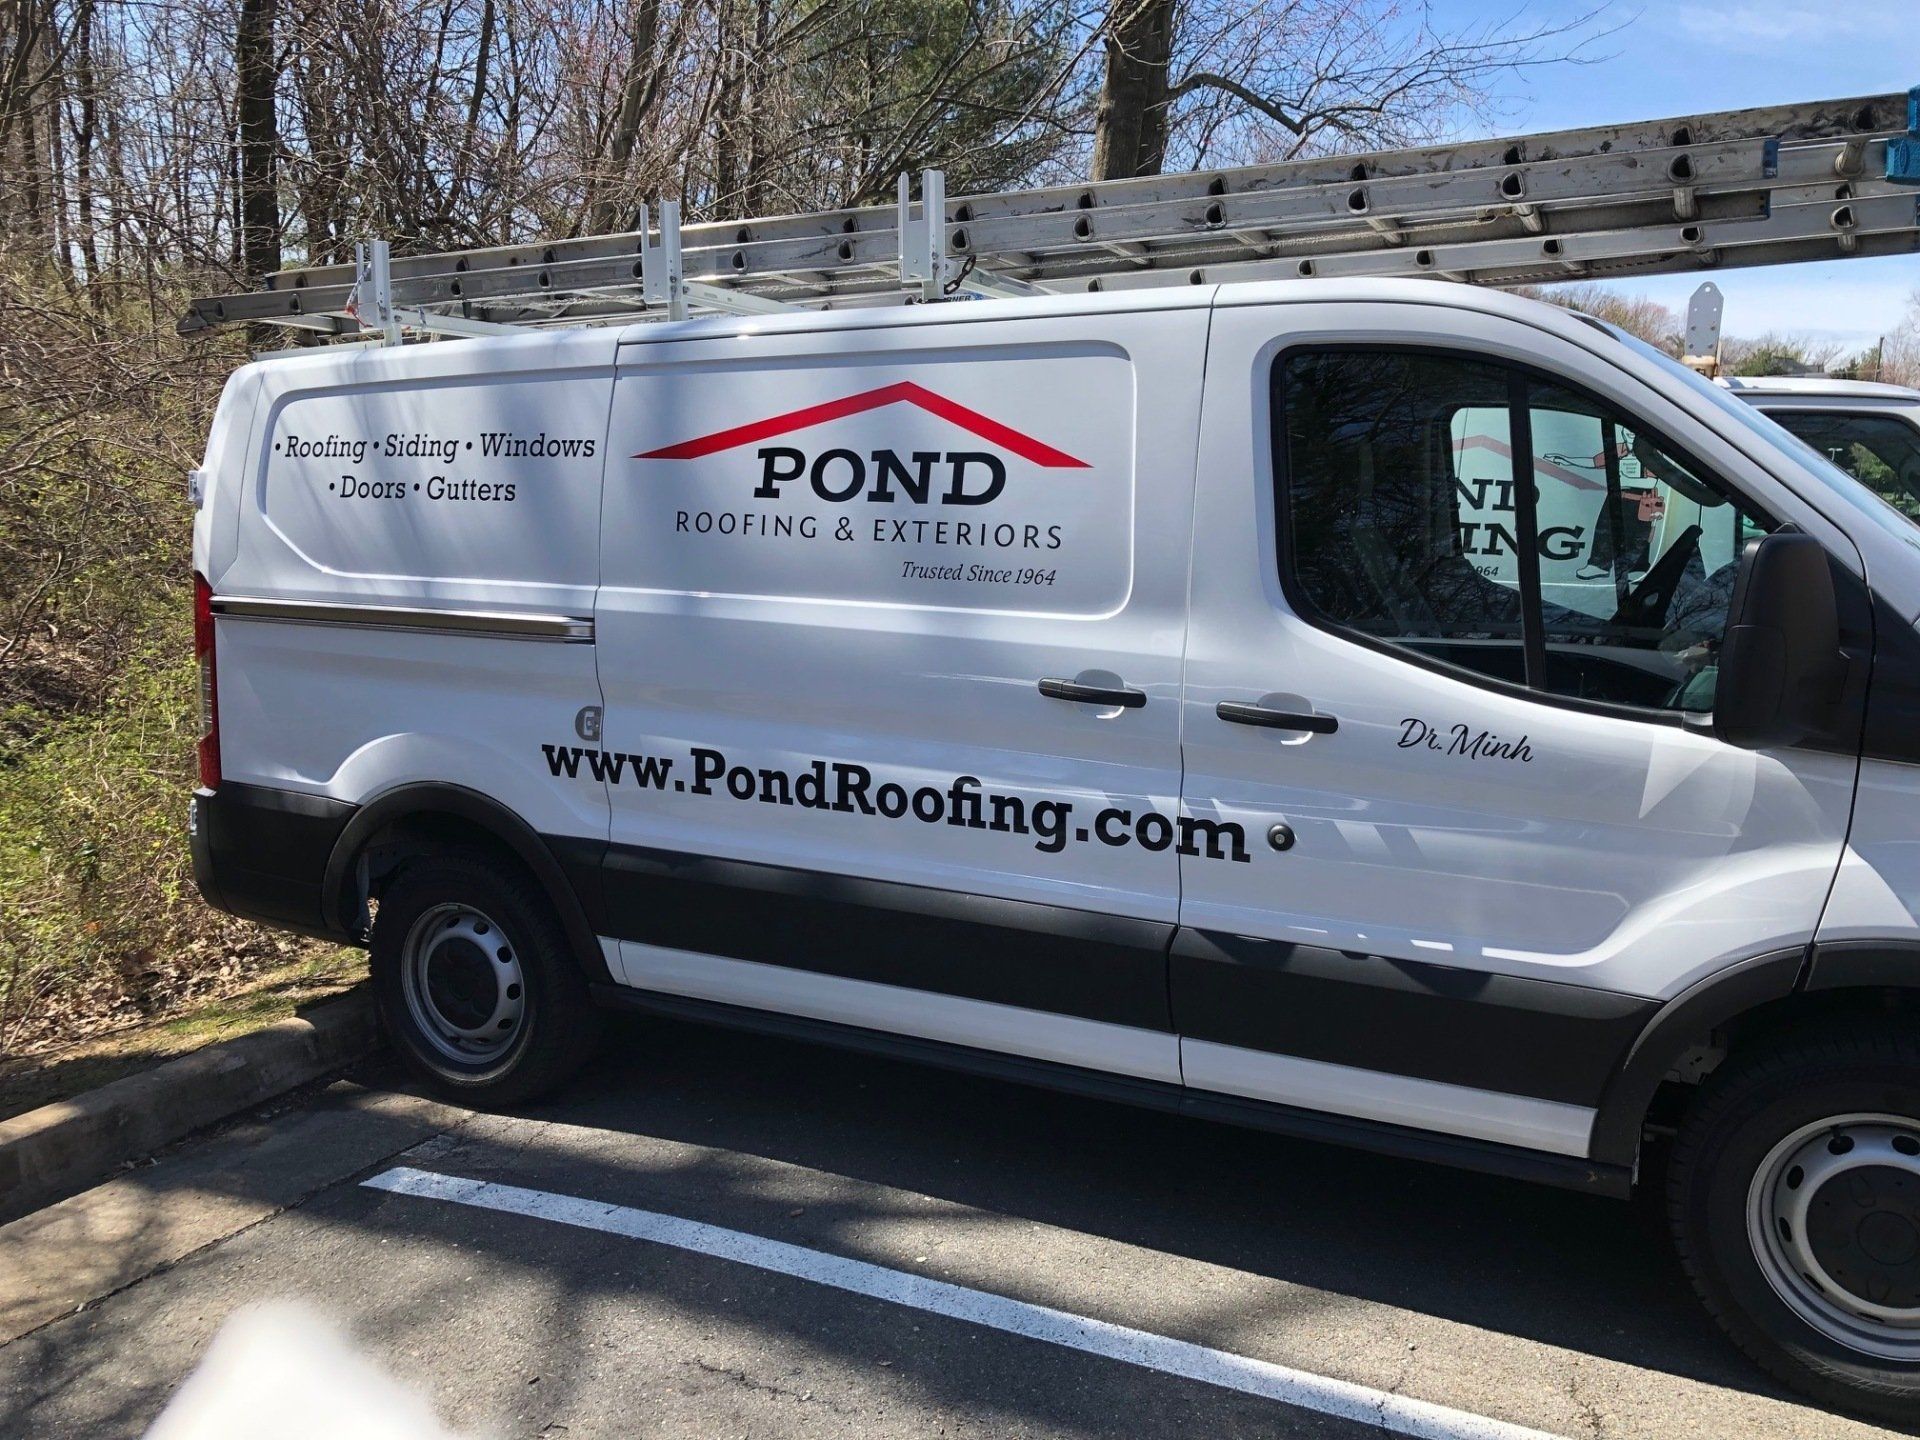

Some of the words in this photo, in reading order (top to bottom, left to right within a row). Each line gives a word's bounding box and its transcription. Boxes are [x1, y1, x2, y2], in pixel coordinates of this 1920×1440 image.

[285, 435, 367, 463] Roofing
[384, 434, 459, 463] Siding
[480, 433, 596, 457] Windows
[340, 476, 406, 499] Doors
[426, 476, 516, 501] Gutters
[753, 446, 1007, 506] POND
[676, 511, 817, 539] ROOFING
[835, 517, 854, 541] &
[874, 519, 1062, 549] EXTERIORS
[901, 561, 963, 581] Trusted
[966, 564, 1012, 584] Since
[1013, 568, 1057, 586] 1964
[1397, 718, 1443, 750] Dr.
[1447, 723, 1534, 763] Minh
[541, 744, 1251, 863] www.PondRoofing.com
